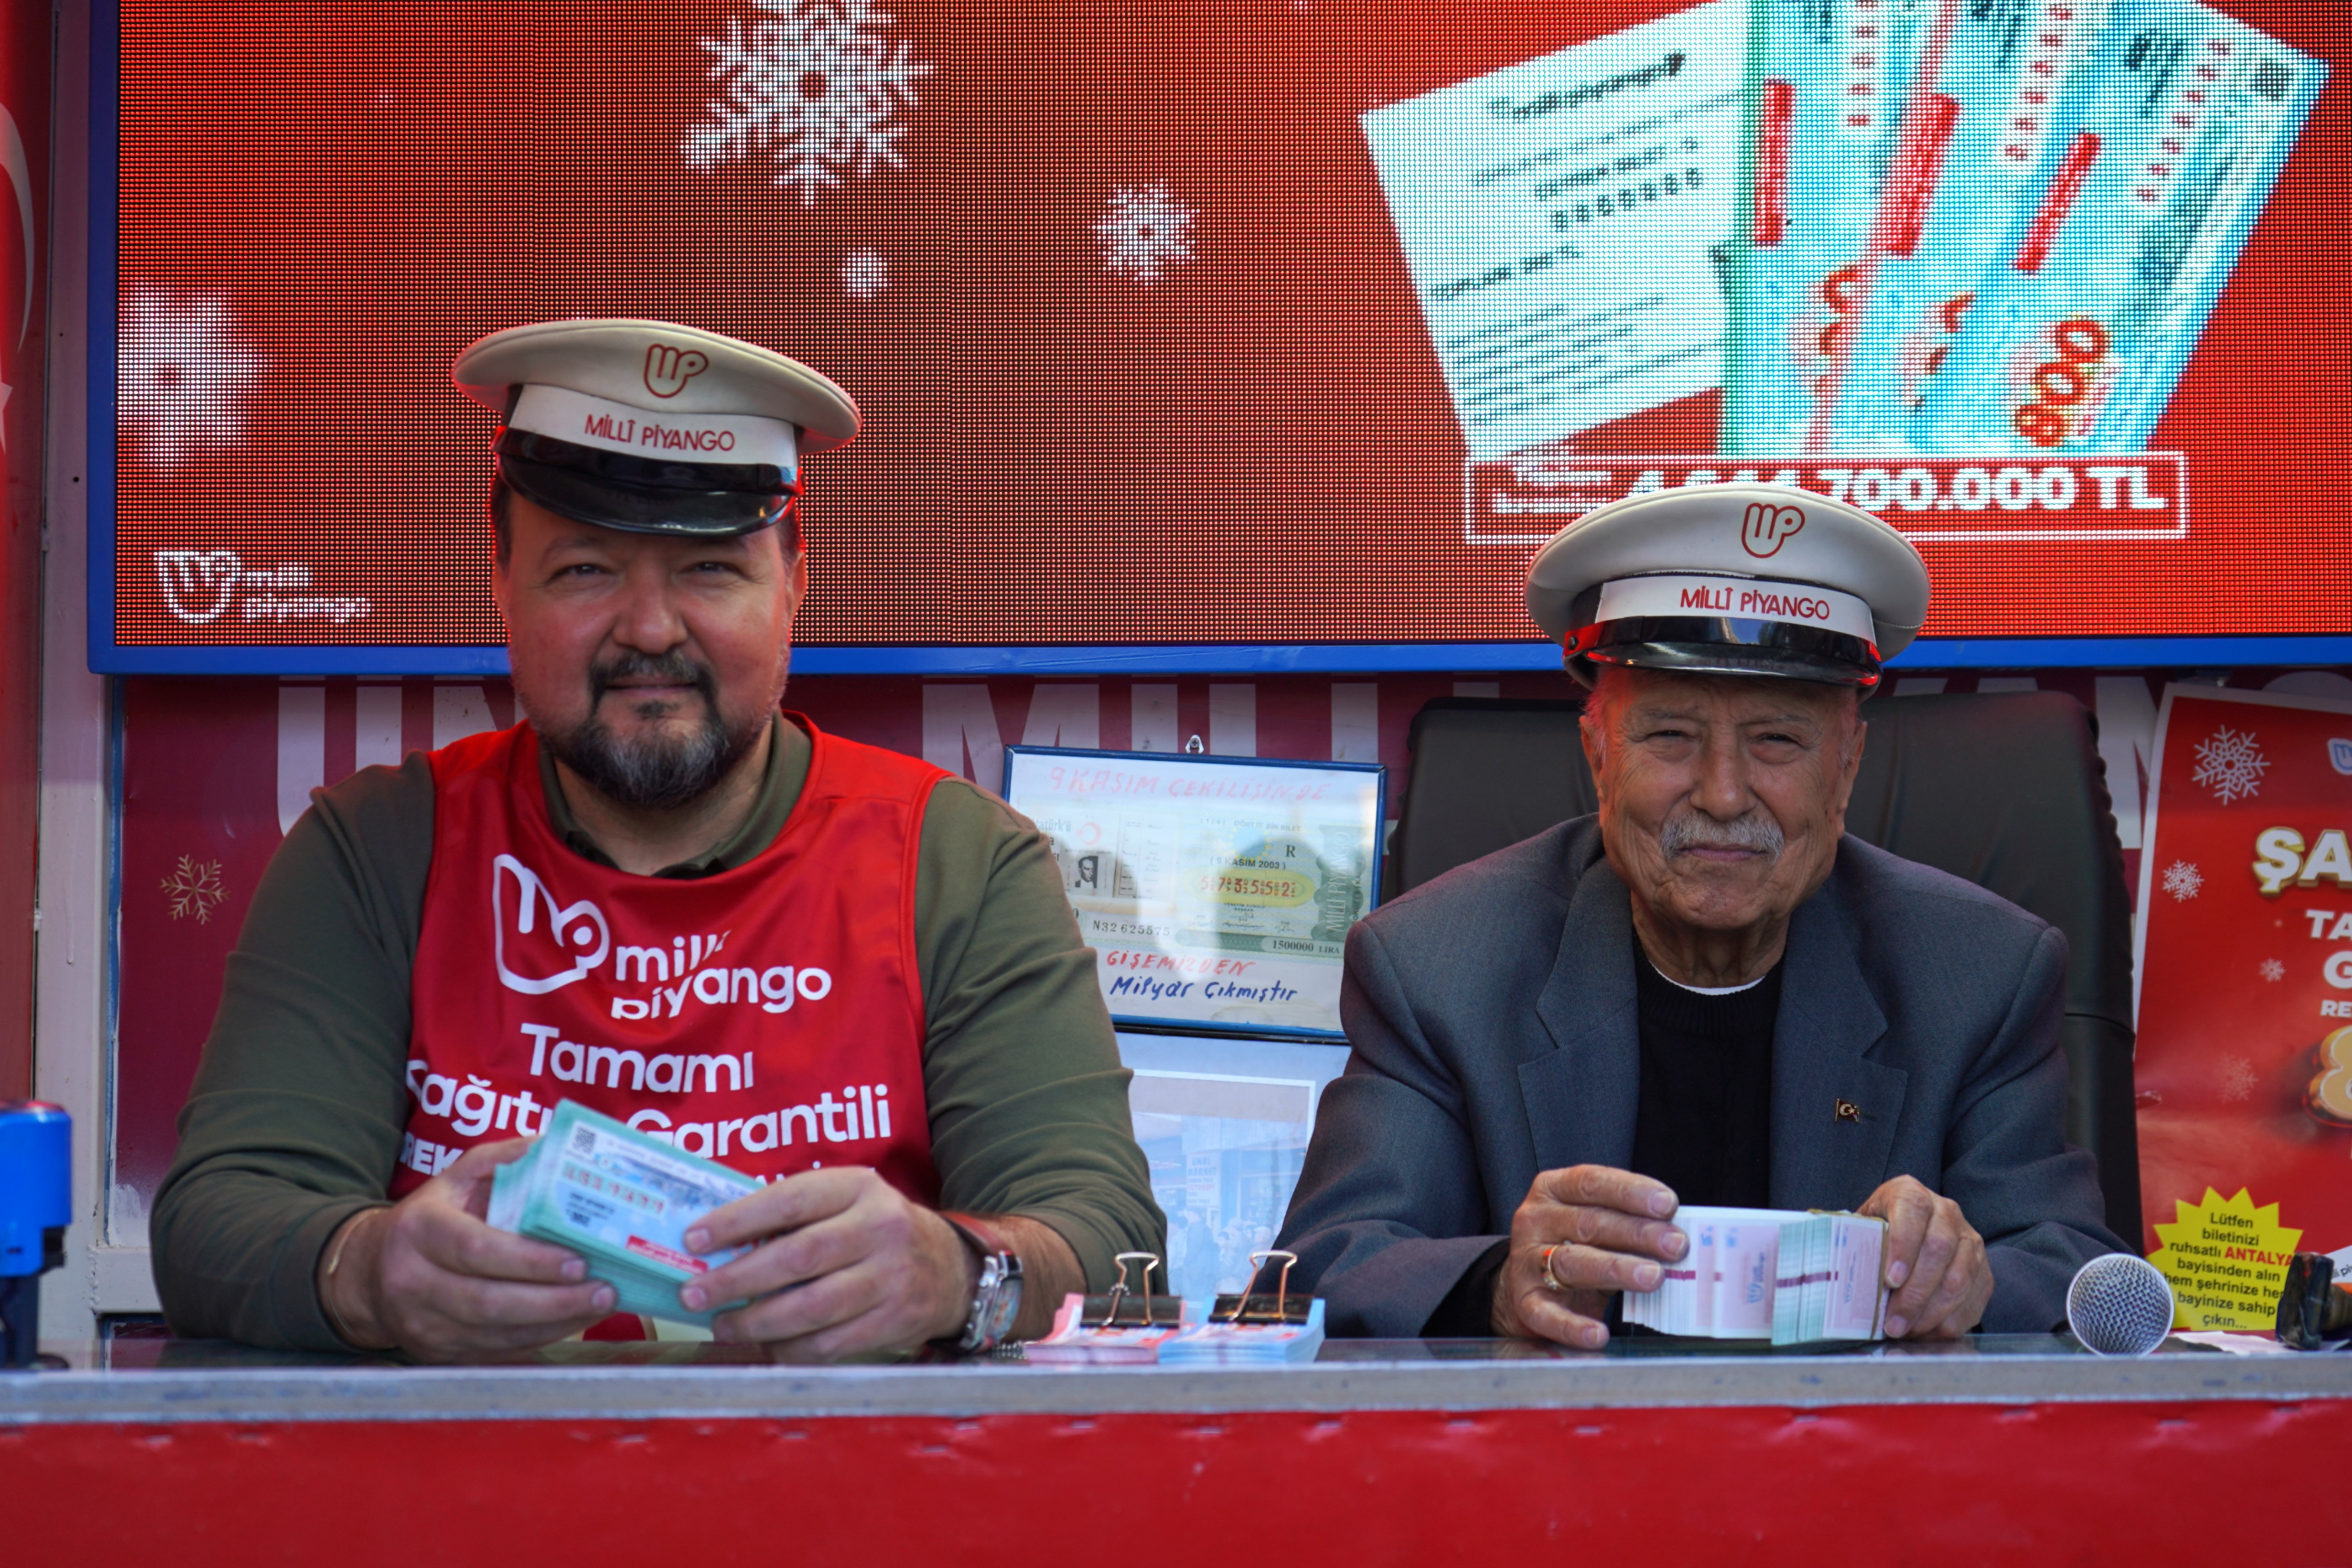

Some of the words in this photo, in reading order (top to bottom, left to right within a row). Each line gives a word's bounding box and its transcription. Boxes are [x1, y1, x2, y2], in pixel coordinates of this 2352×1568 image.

[641, 424, 735, 451] PİYANGO
[2087, 466, 2167, 509] TL
[1740, 589, 1829, 620] PİYANGO
[1069, 768, 1160, 795] KASIM
[1033, 818, 1072, 832] tatürk'ü
[1224, 857, 1256, 867] KASIM
[1286, 844, 1296, 858] R
[1273, 940, 1314, 952] 1500000
[610, 965, 832, 1020] piyango
[520, 1023, 754, 1094] Tamamı
[2210, 1212, 2253, 1229] Lütfen
[2202, 1228, 2260, 1246] biletinizi
[2170, 1241, 2221, 1257] ruhsatlı
[2177, 1257, 2251, 1278] bayisinden
[2255, 1272, 2280, 1282] alın
[2197, 1277, 2259, 1296] şehrinize
[2177, 1291, 2234, 1310] bayinize
[2238, 1300, 2276, 1317] sahip
